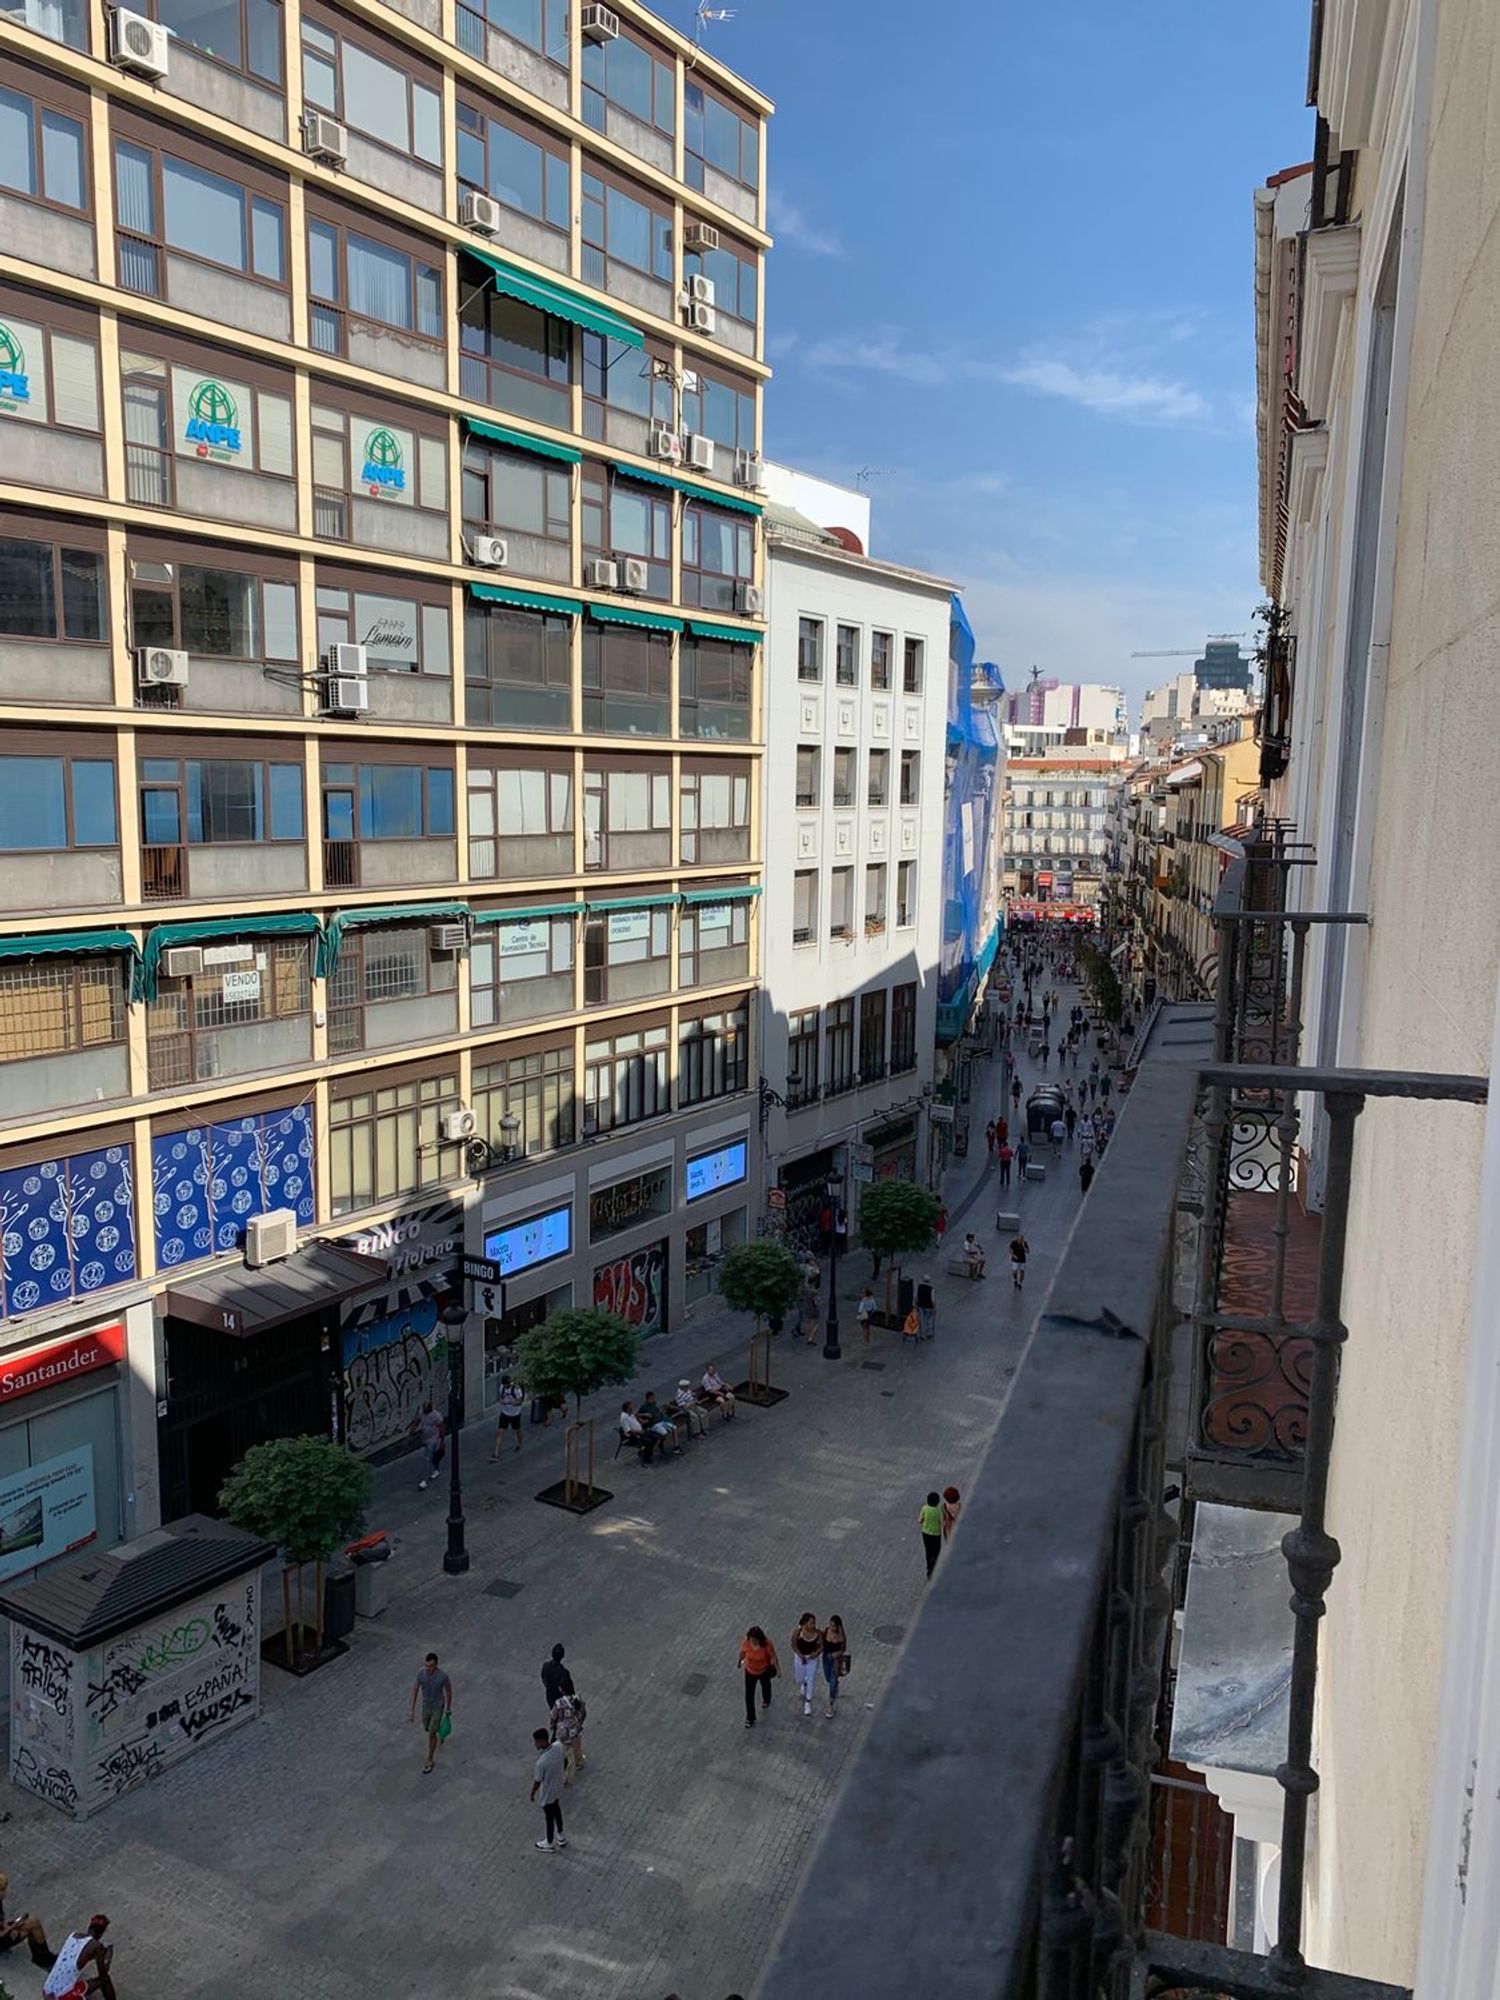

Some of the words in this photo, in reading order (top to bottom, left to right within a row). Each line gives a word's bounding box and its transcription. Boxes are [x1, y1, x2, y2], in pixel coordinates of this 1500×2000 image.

[186, 418, 241, 449] ANPE
[362, 461, 405, 488] ANPE
[225, 972, 257, 987] VENDO
[357, 1220, 421, 1255] BINGO
[464, 1261, 494, 1280] BINGO
[223, 1312, 235, 1329] 14
[2, 1348, 98, 1393] Santander
[185, 1656, 248, 1709] ESPAÑA!
